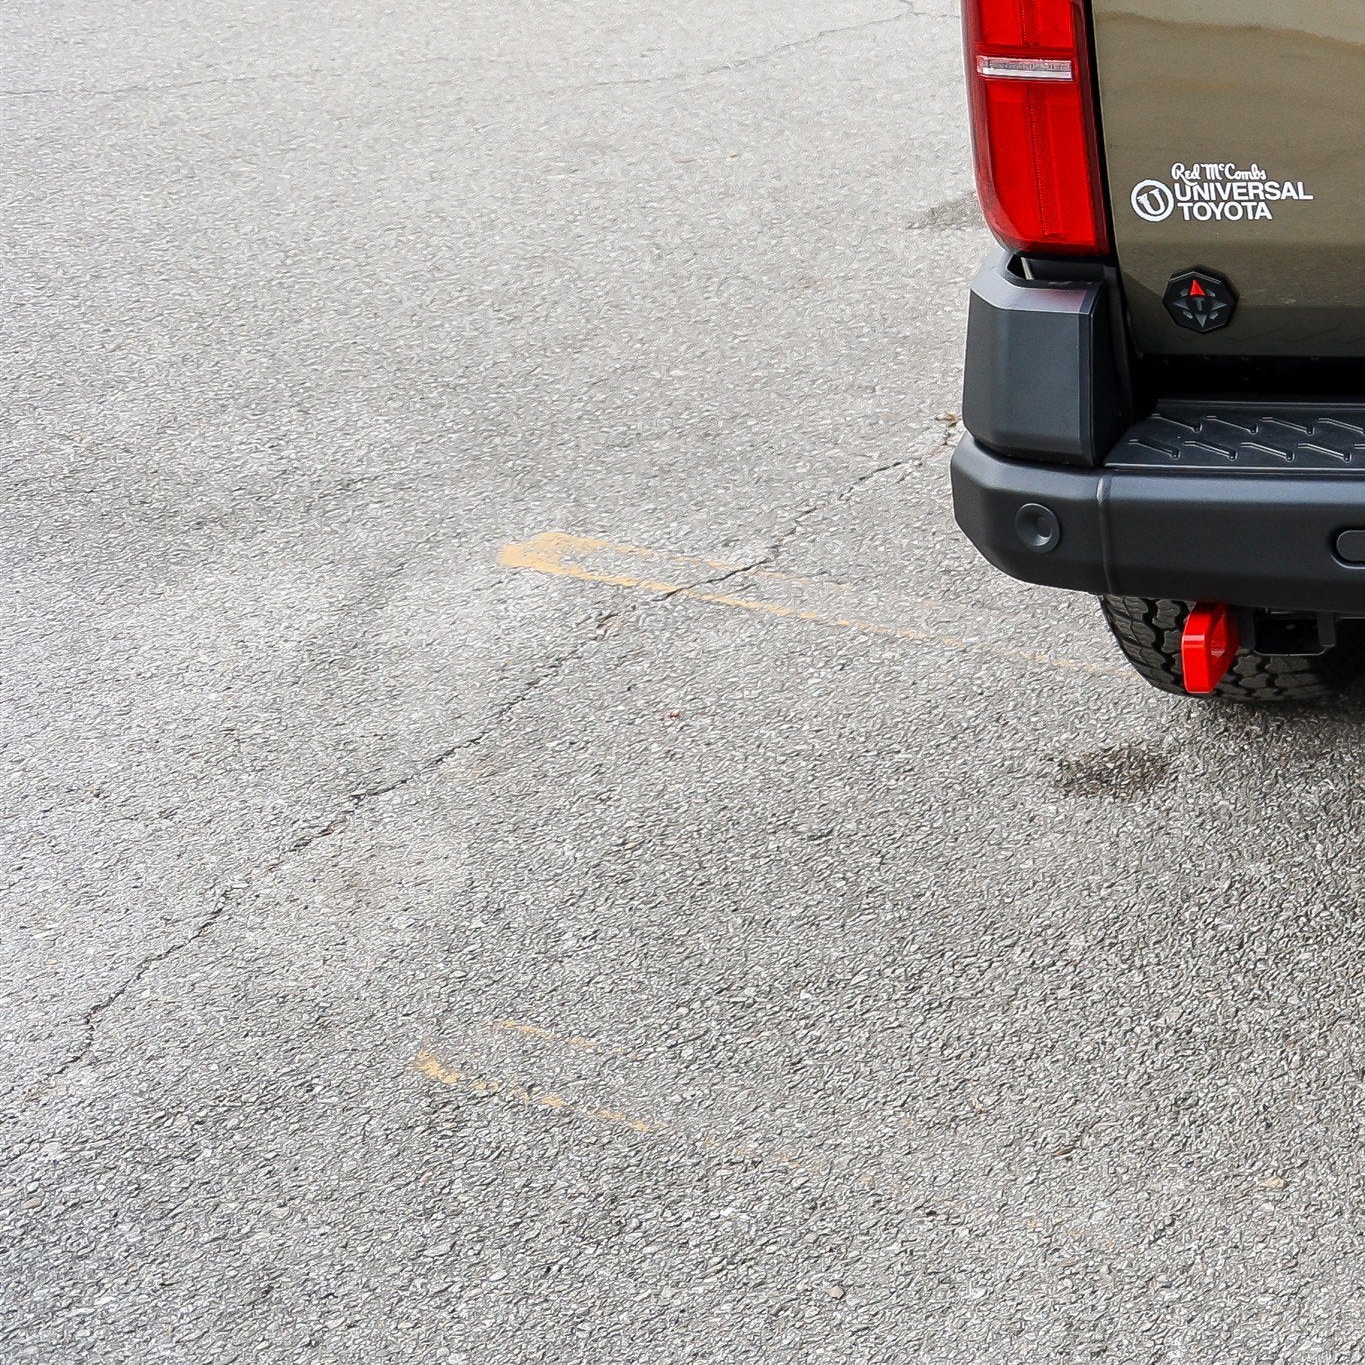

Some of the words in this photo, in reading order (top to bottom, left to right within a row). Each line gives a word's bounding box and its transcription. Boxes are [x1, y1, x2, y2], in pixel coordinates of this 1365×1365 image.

[1171, 162, 1201, 184] Red
[1200, 162, 1267, 181] McCombs
[1174, 181, 1314, 201] UNIVERSAL
[1177, 201, 1274, 221] TOYOTA
